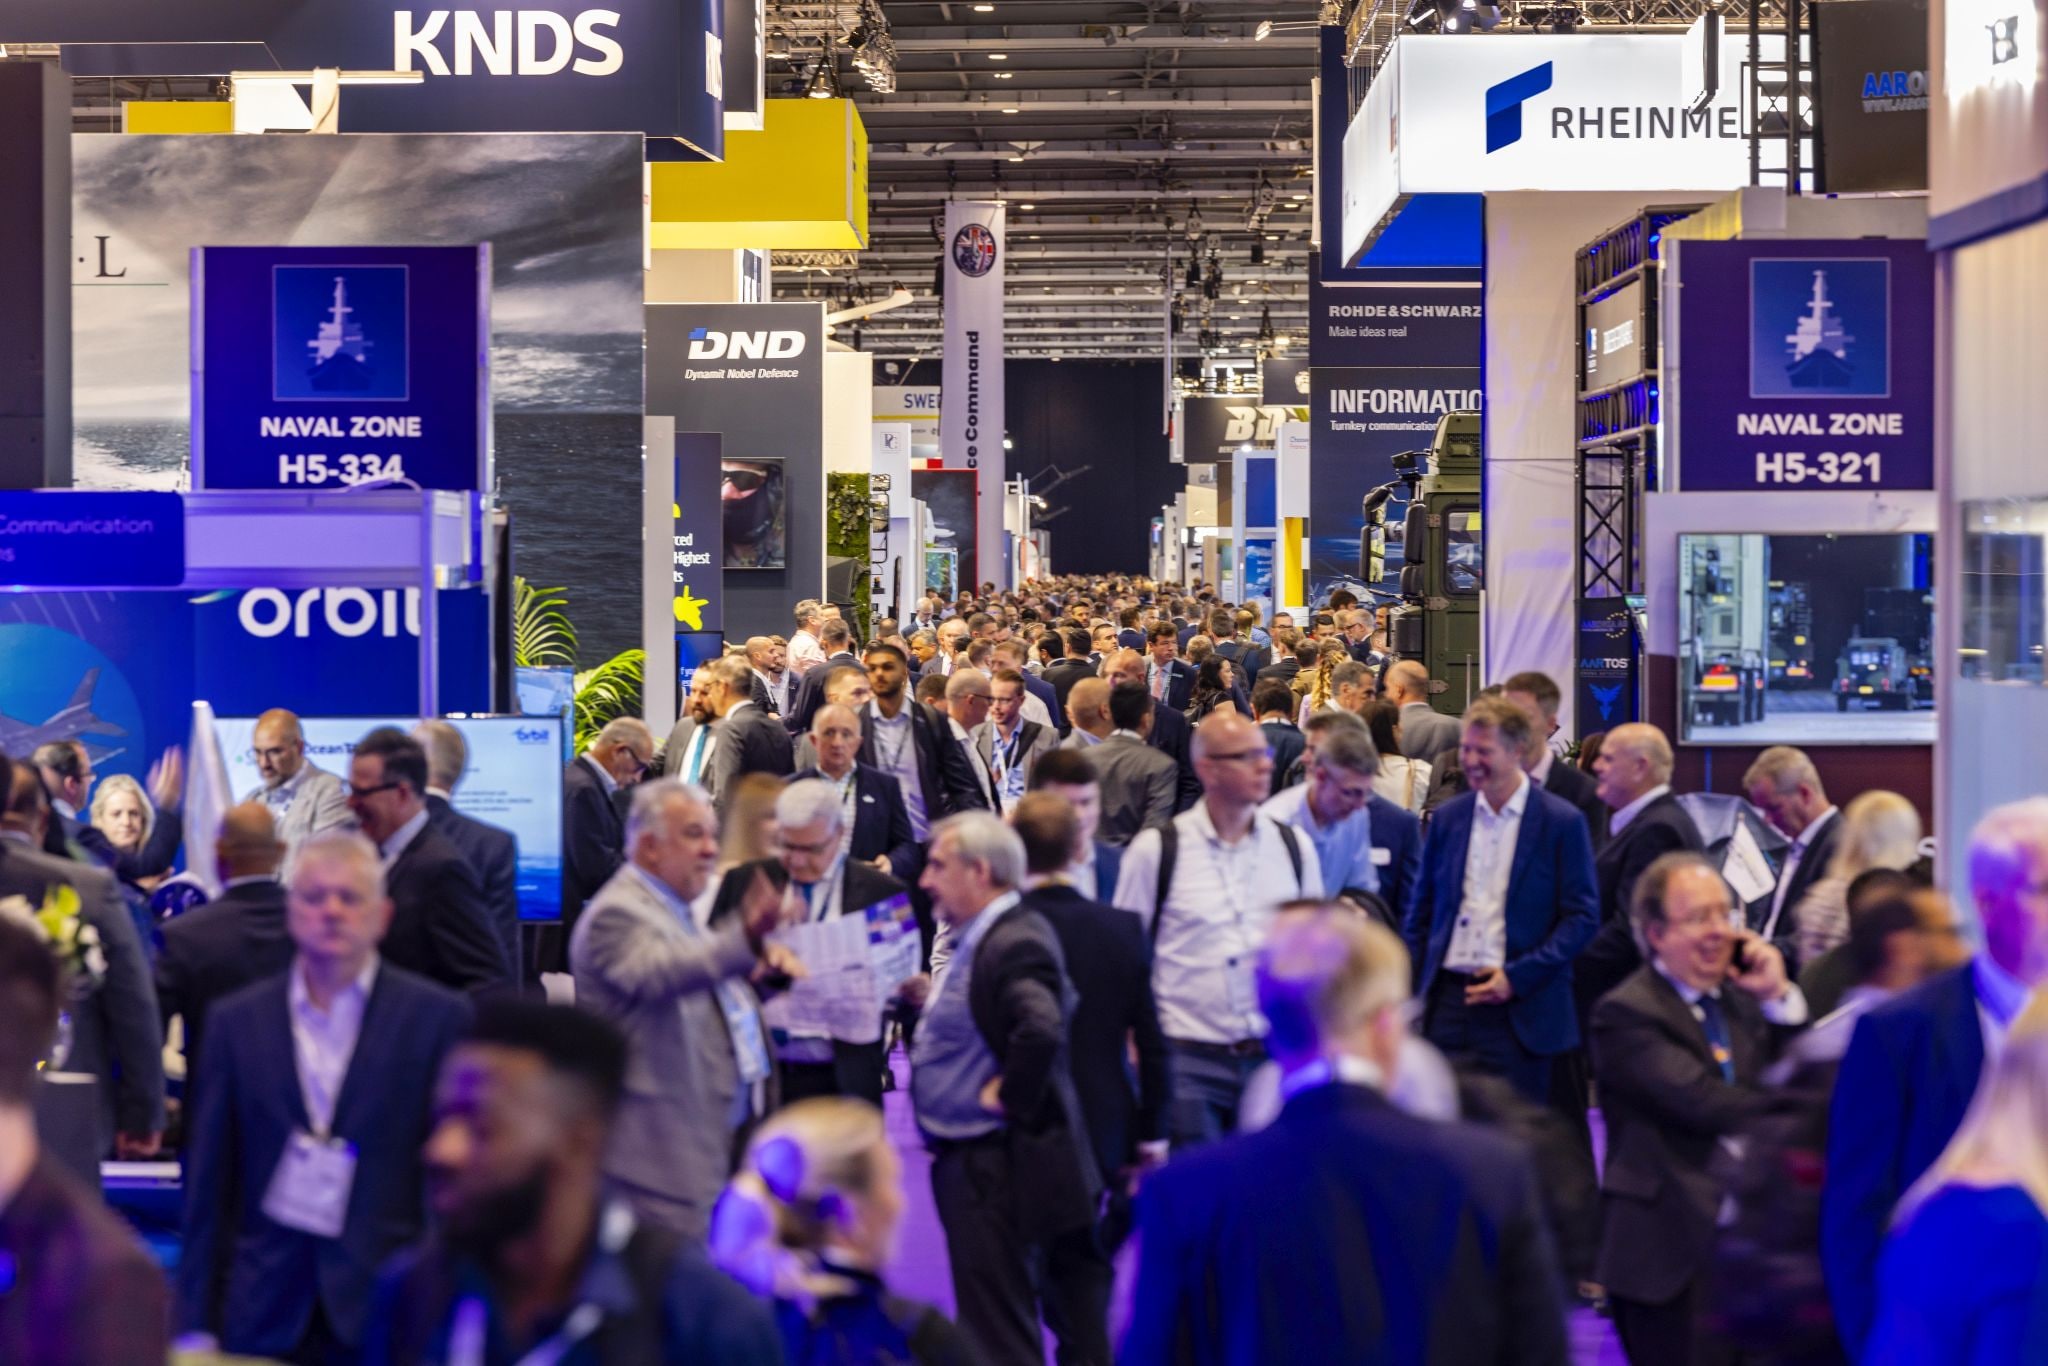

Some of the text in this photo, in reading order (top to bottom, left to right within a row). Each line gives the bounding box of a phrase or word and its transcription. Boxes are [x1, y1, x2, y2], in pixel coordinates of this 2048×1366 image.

[394, 9, 624, 76] KNDS
[1329, 326, 1407, 337] Make ideas real
[688, 328, 806, 359] DND
[685, 368, 799, 381] Dynamit Nobel Defence
[965, 331, 980, 441] Command
[904, 393, 941, 408] SWE
[260, 416, 422, 438] NAVAL ZONE
[1330, 421, 1366, 432] Turnkey
[1737, 413, 1903, 435] NAVAL ZONE
[279, 454, 405, 484] H5-334
[1756, 452, 1881, 483] H5-321
[673, 551, 711, 567] Highest
[1580, 658, 1630, 669] AARTOS
